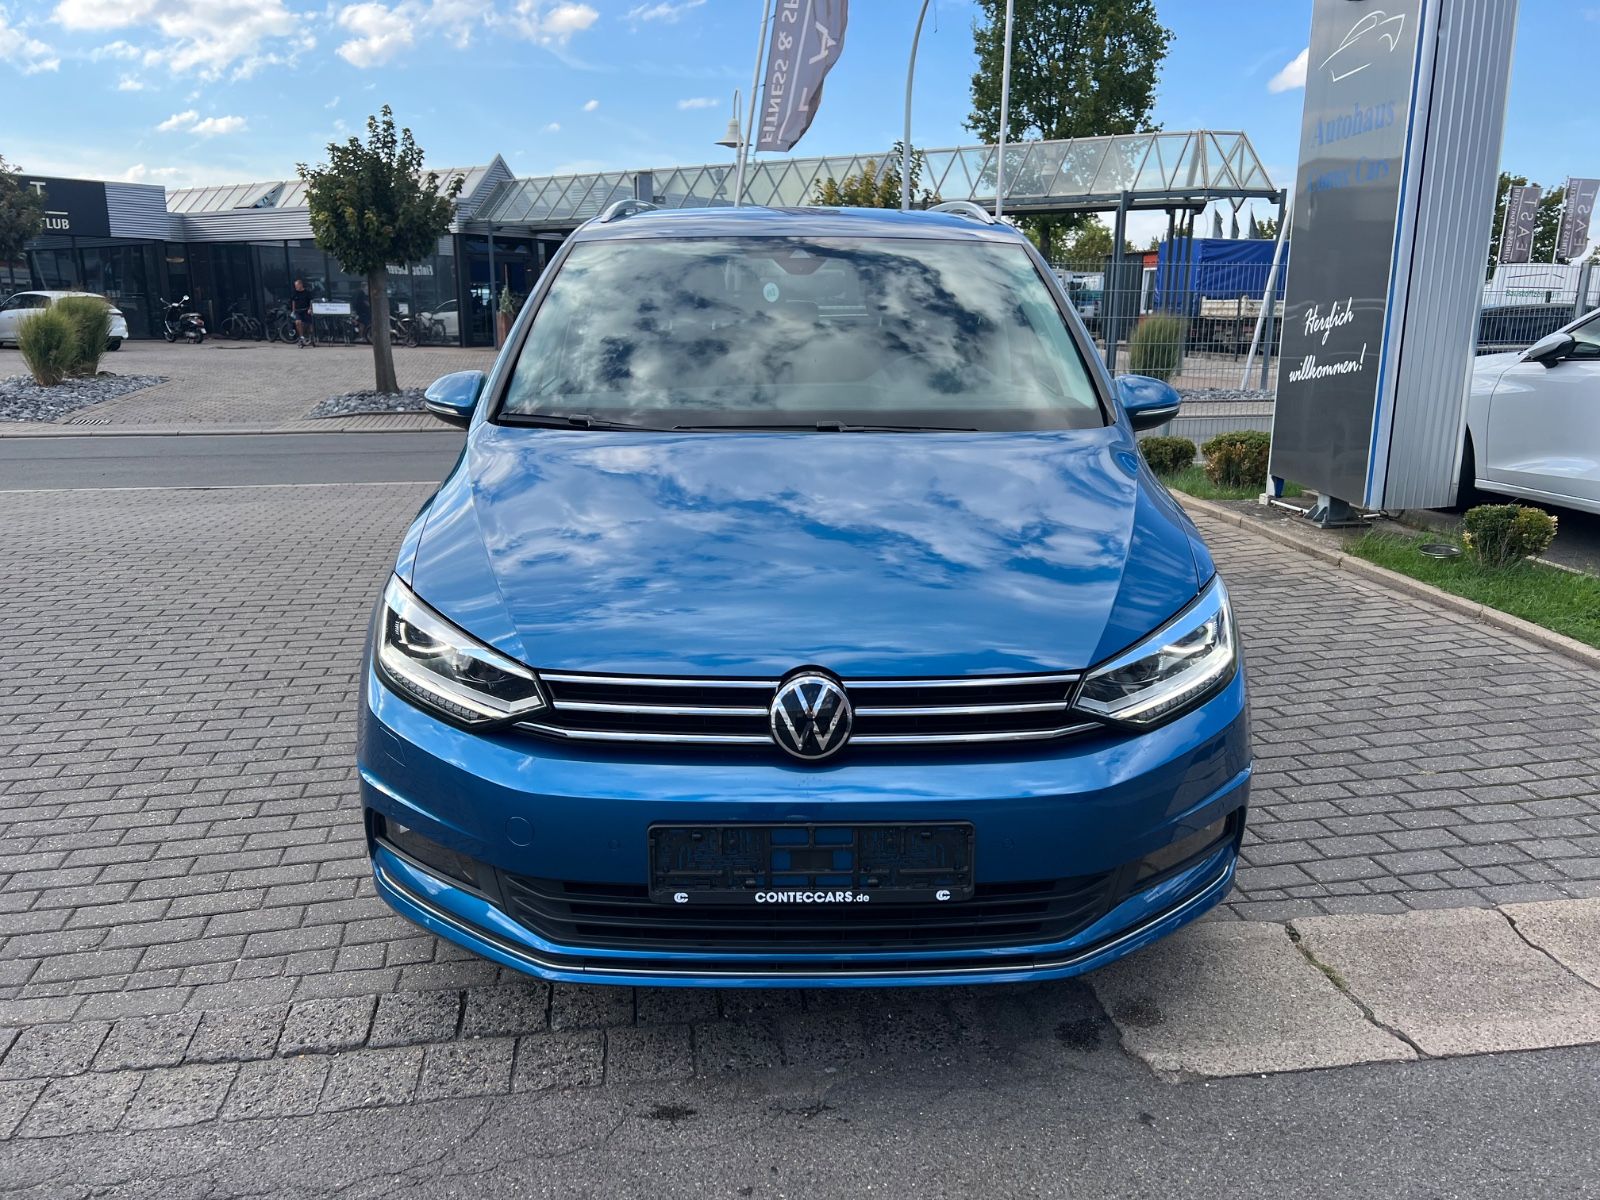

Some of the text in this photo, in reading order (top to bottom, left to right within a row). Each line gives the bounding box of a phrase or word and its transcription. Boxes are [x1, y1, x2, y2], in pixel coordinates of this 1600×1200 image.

[1313, 100, 1395, 147] Autohaus
[41, 217, 70, 230] LUB
[1304, 296, 1354, 346] Herzlich
[1289, 342, 1366, 382] willkommen!
[754, 891, 870, 903] CONTECCARS.de
